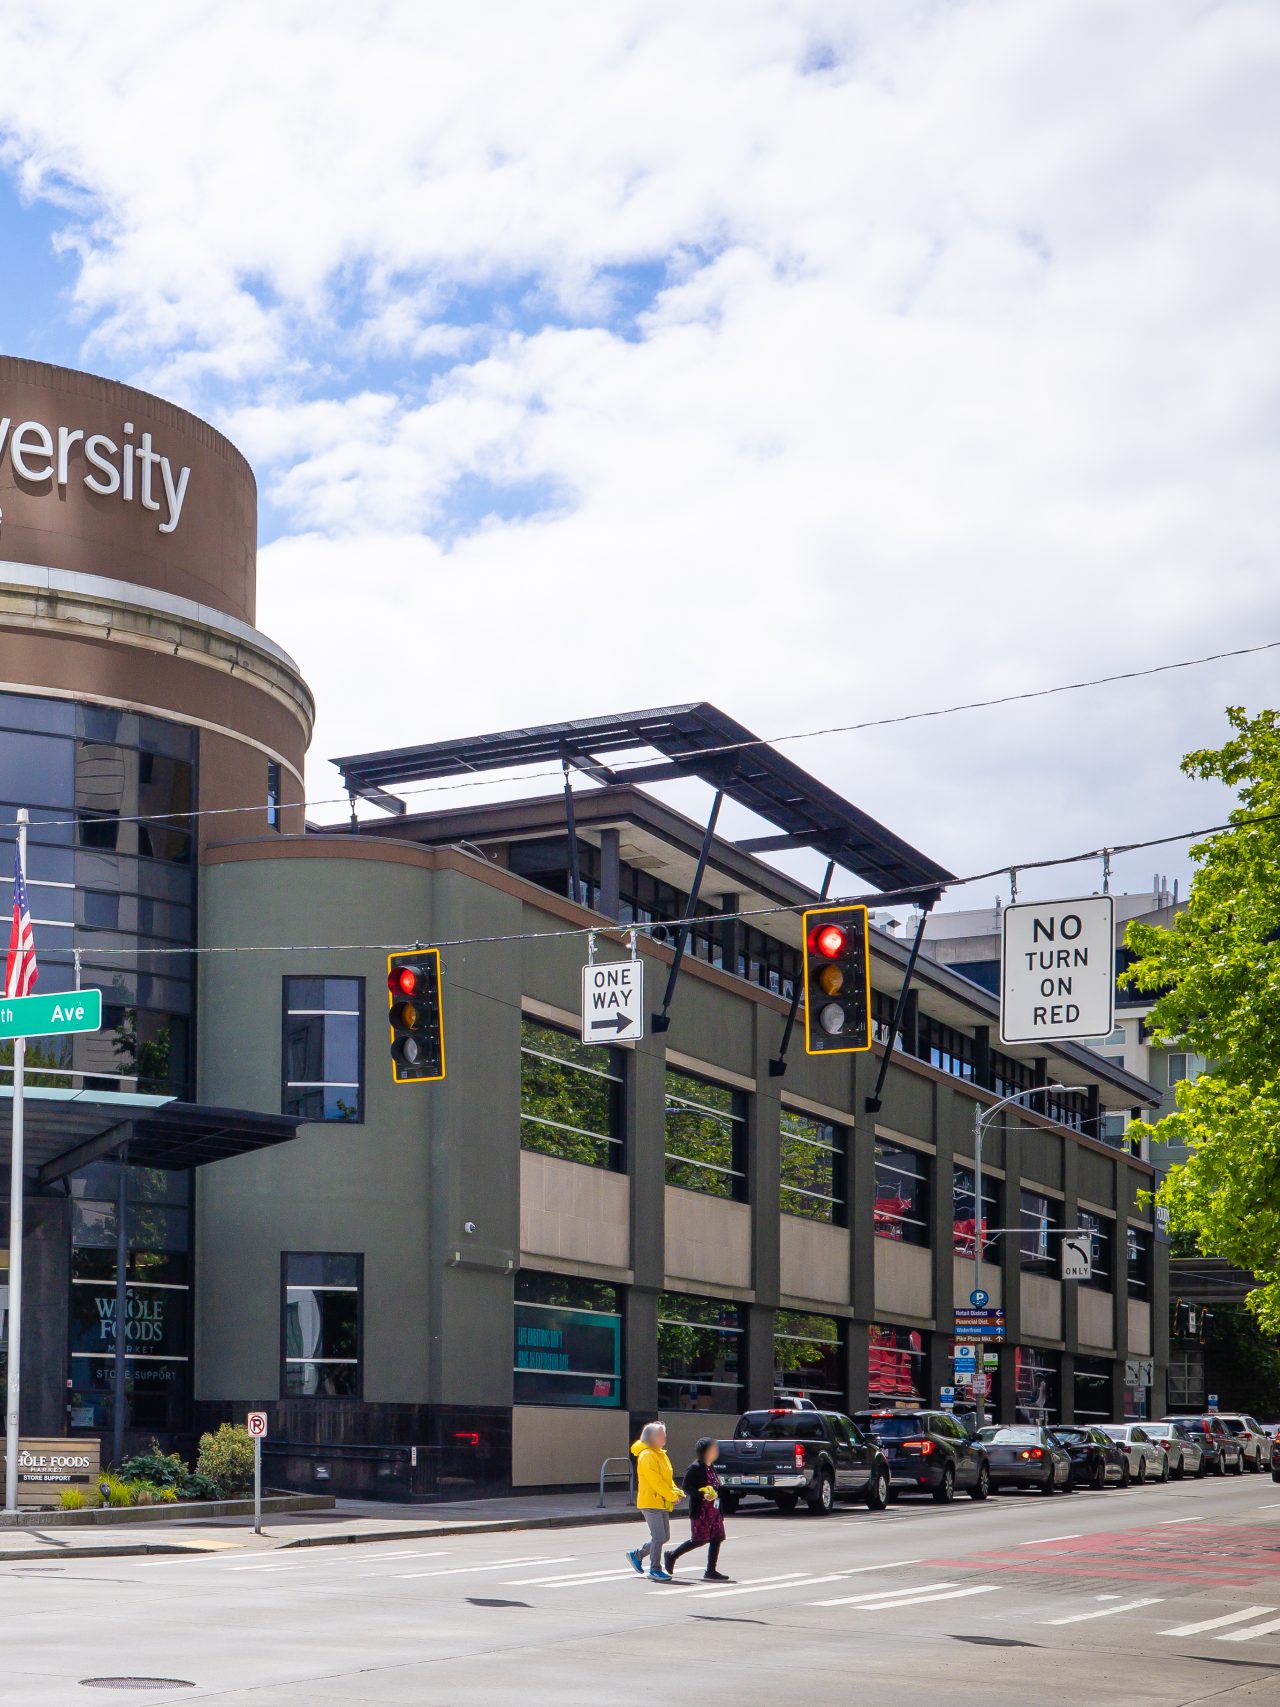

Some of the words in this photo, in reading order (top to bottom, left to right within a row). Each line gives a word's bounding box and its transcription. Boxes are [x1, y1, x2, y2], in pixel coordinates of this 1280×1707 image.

[1033, 914, 1082, 943] NO
[1025, 947, 1088, 971] TURN
[594, 968, 631, 988] ONE
[1040, 976, 1072, 997] ON
[592, 989, 632, 1009] WAY
[50, 1004, 85, 1023] Ave
[1033, 1004, 1080, 1026] RED
[1065, 1267, 1089, 1275] ONLY
[107, 1344, 155, 1354] MRKET
[96, 1369, 131, 1379] STOE
[135, 1370, 177, 1380] SUPPORT
[50, 1455, 90, 1468] FOODS
